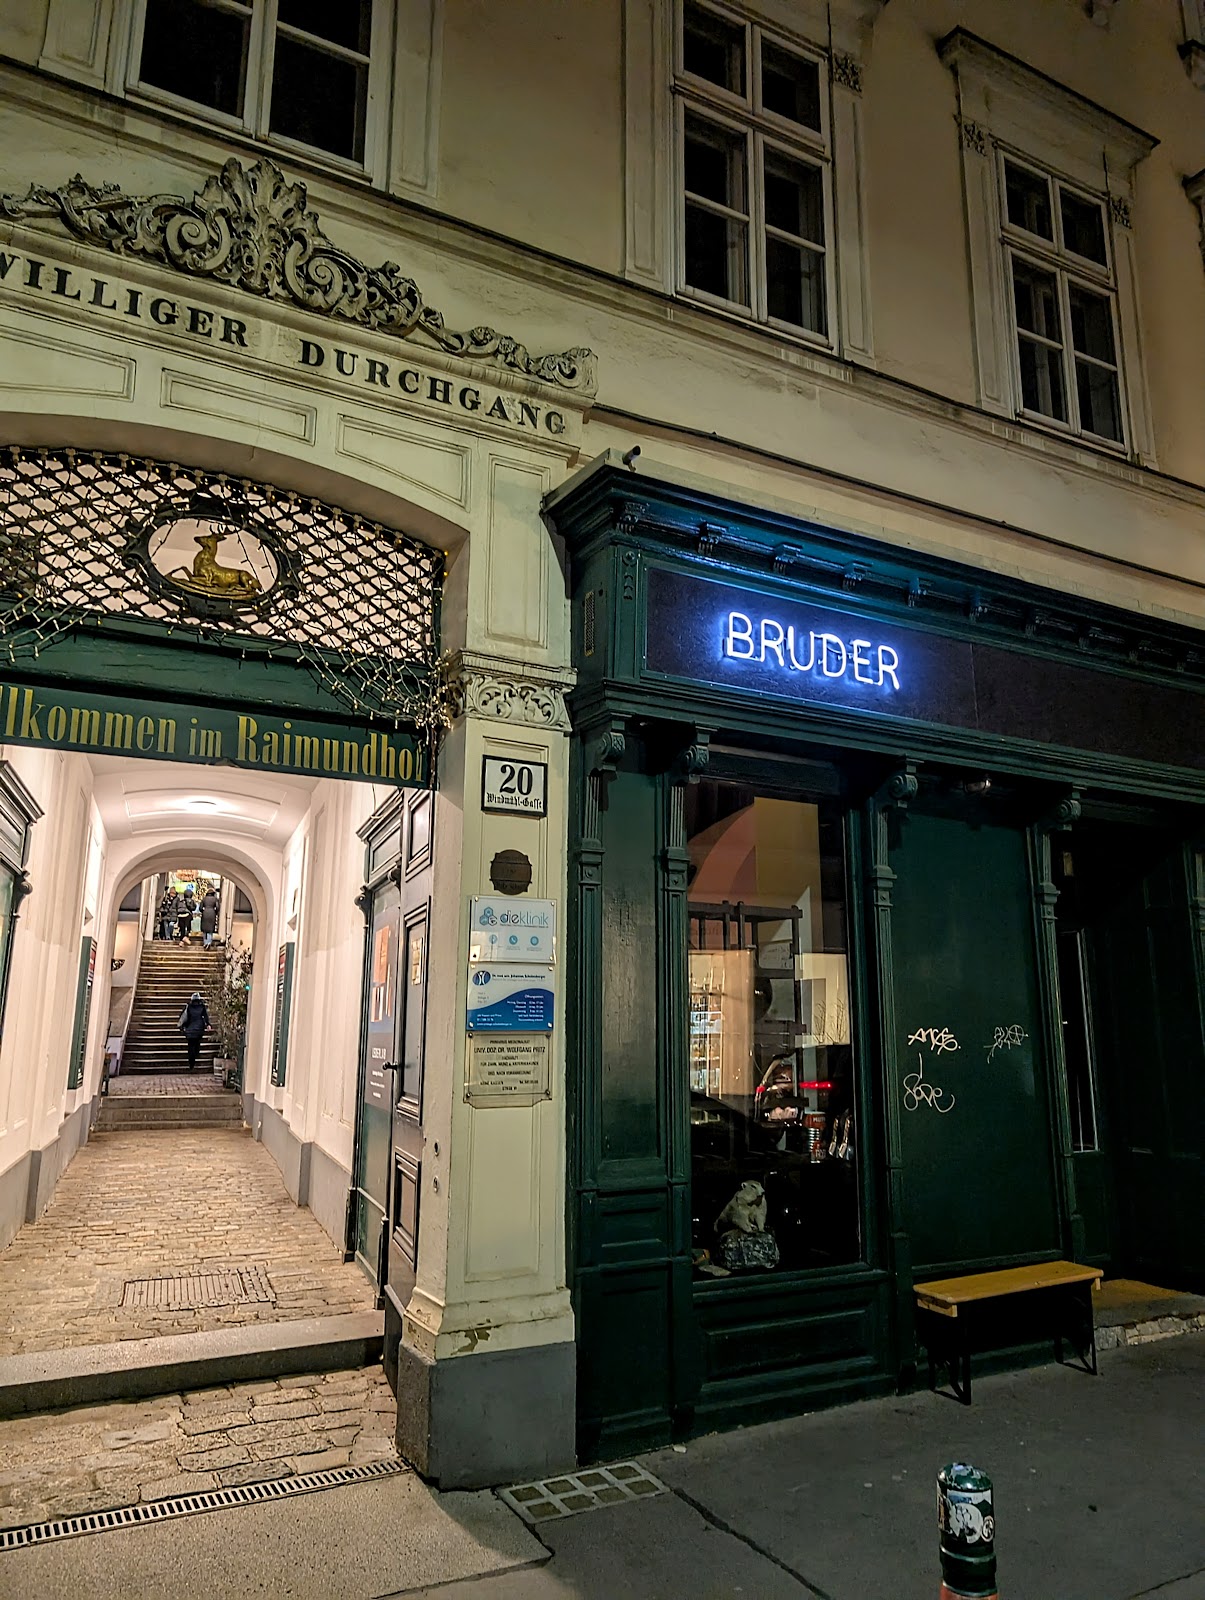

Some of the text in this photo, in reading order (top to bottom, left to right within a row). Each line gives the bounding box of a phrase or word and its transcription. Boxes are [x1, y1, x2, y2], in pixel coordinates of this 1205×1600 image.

[298, 339, 565, 435] DURCHGANG
[727, 611, 900, 690] BRUDER
[0, 685, 176, 754] lkommen
[189, 717, 222, 759] im
[500, 764, 533, 795] 20
